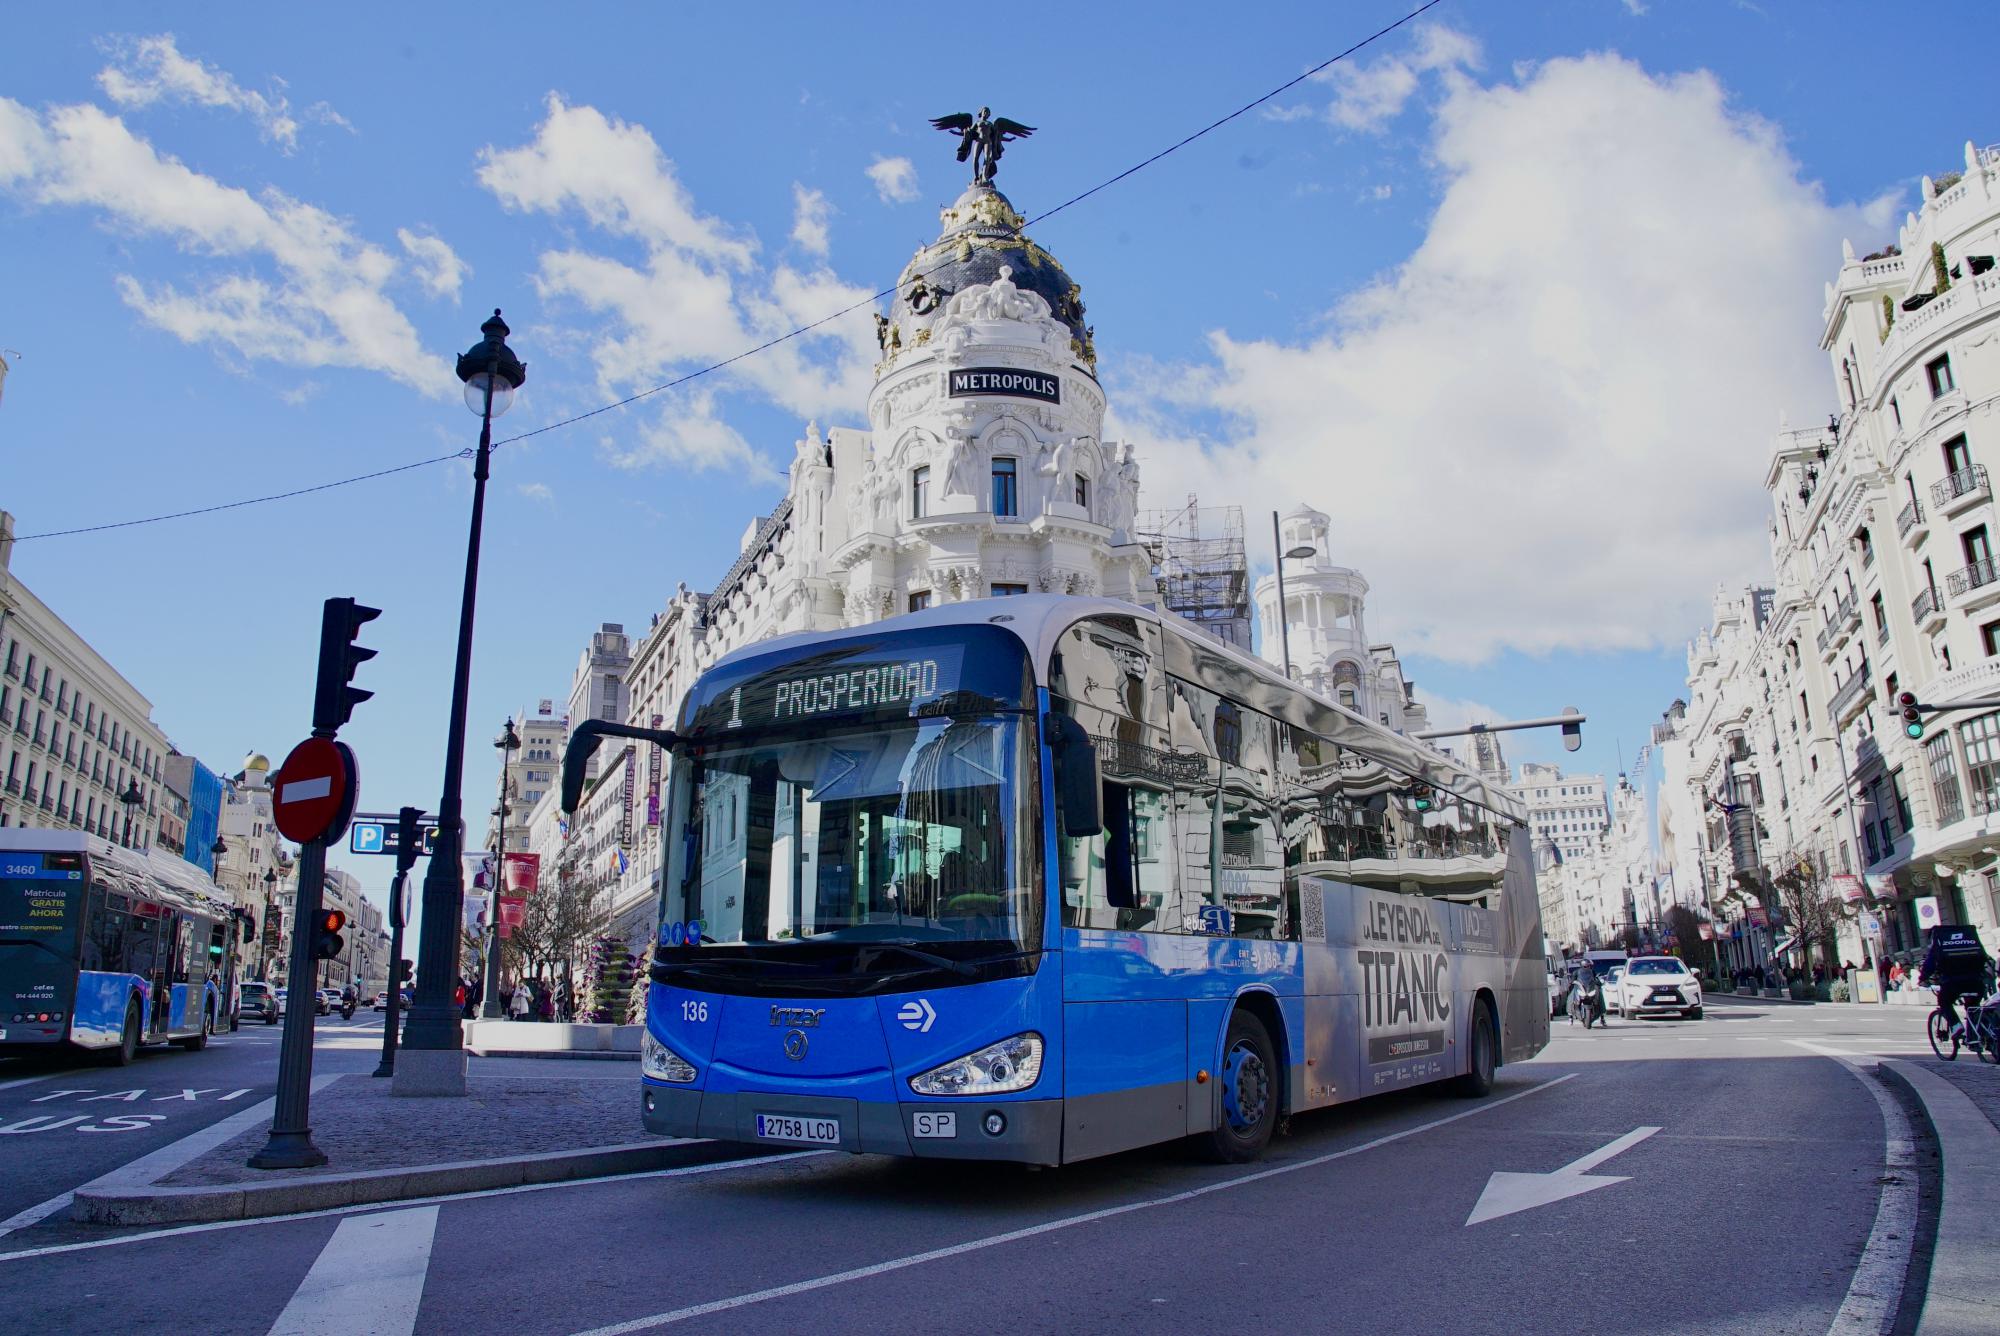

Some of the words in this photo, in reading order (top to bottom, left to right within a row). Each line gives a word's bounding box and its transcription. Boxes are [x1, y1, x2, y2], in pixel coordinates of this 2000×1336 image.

[955, 374, 1055, 395] METROPOLIS
[727, 687, 742, 728] 1
[775, 660, 937, 717] PROSPERIDAD
[625, 770, 634, 812] MUJERES
[360, 828, 376, 848] P
[624, 829, 632, 843] POR
[6, 865, 35, 875] 3460
[24, 889, 66, 898] Matrícula
[1369, 900, 1433, 944] LEYENDA
[1358, 951, 1450, 1028] TITANIC
[681, 1001, 708, 1022] 136
[31, 1089, 254, 1101] TAXI
[0, 1115, 167, 1134] US
[766, 1119, 802, 1138] 2758
[807, 1121, 835, 1140] LCD
[918, 1115, 950, 1134] SP
